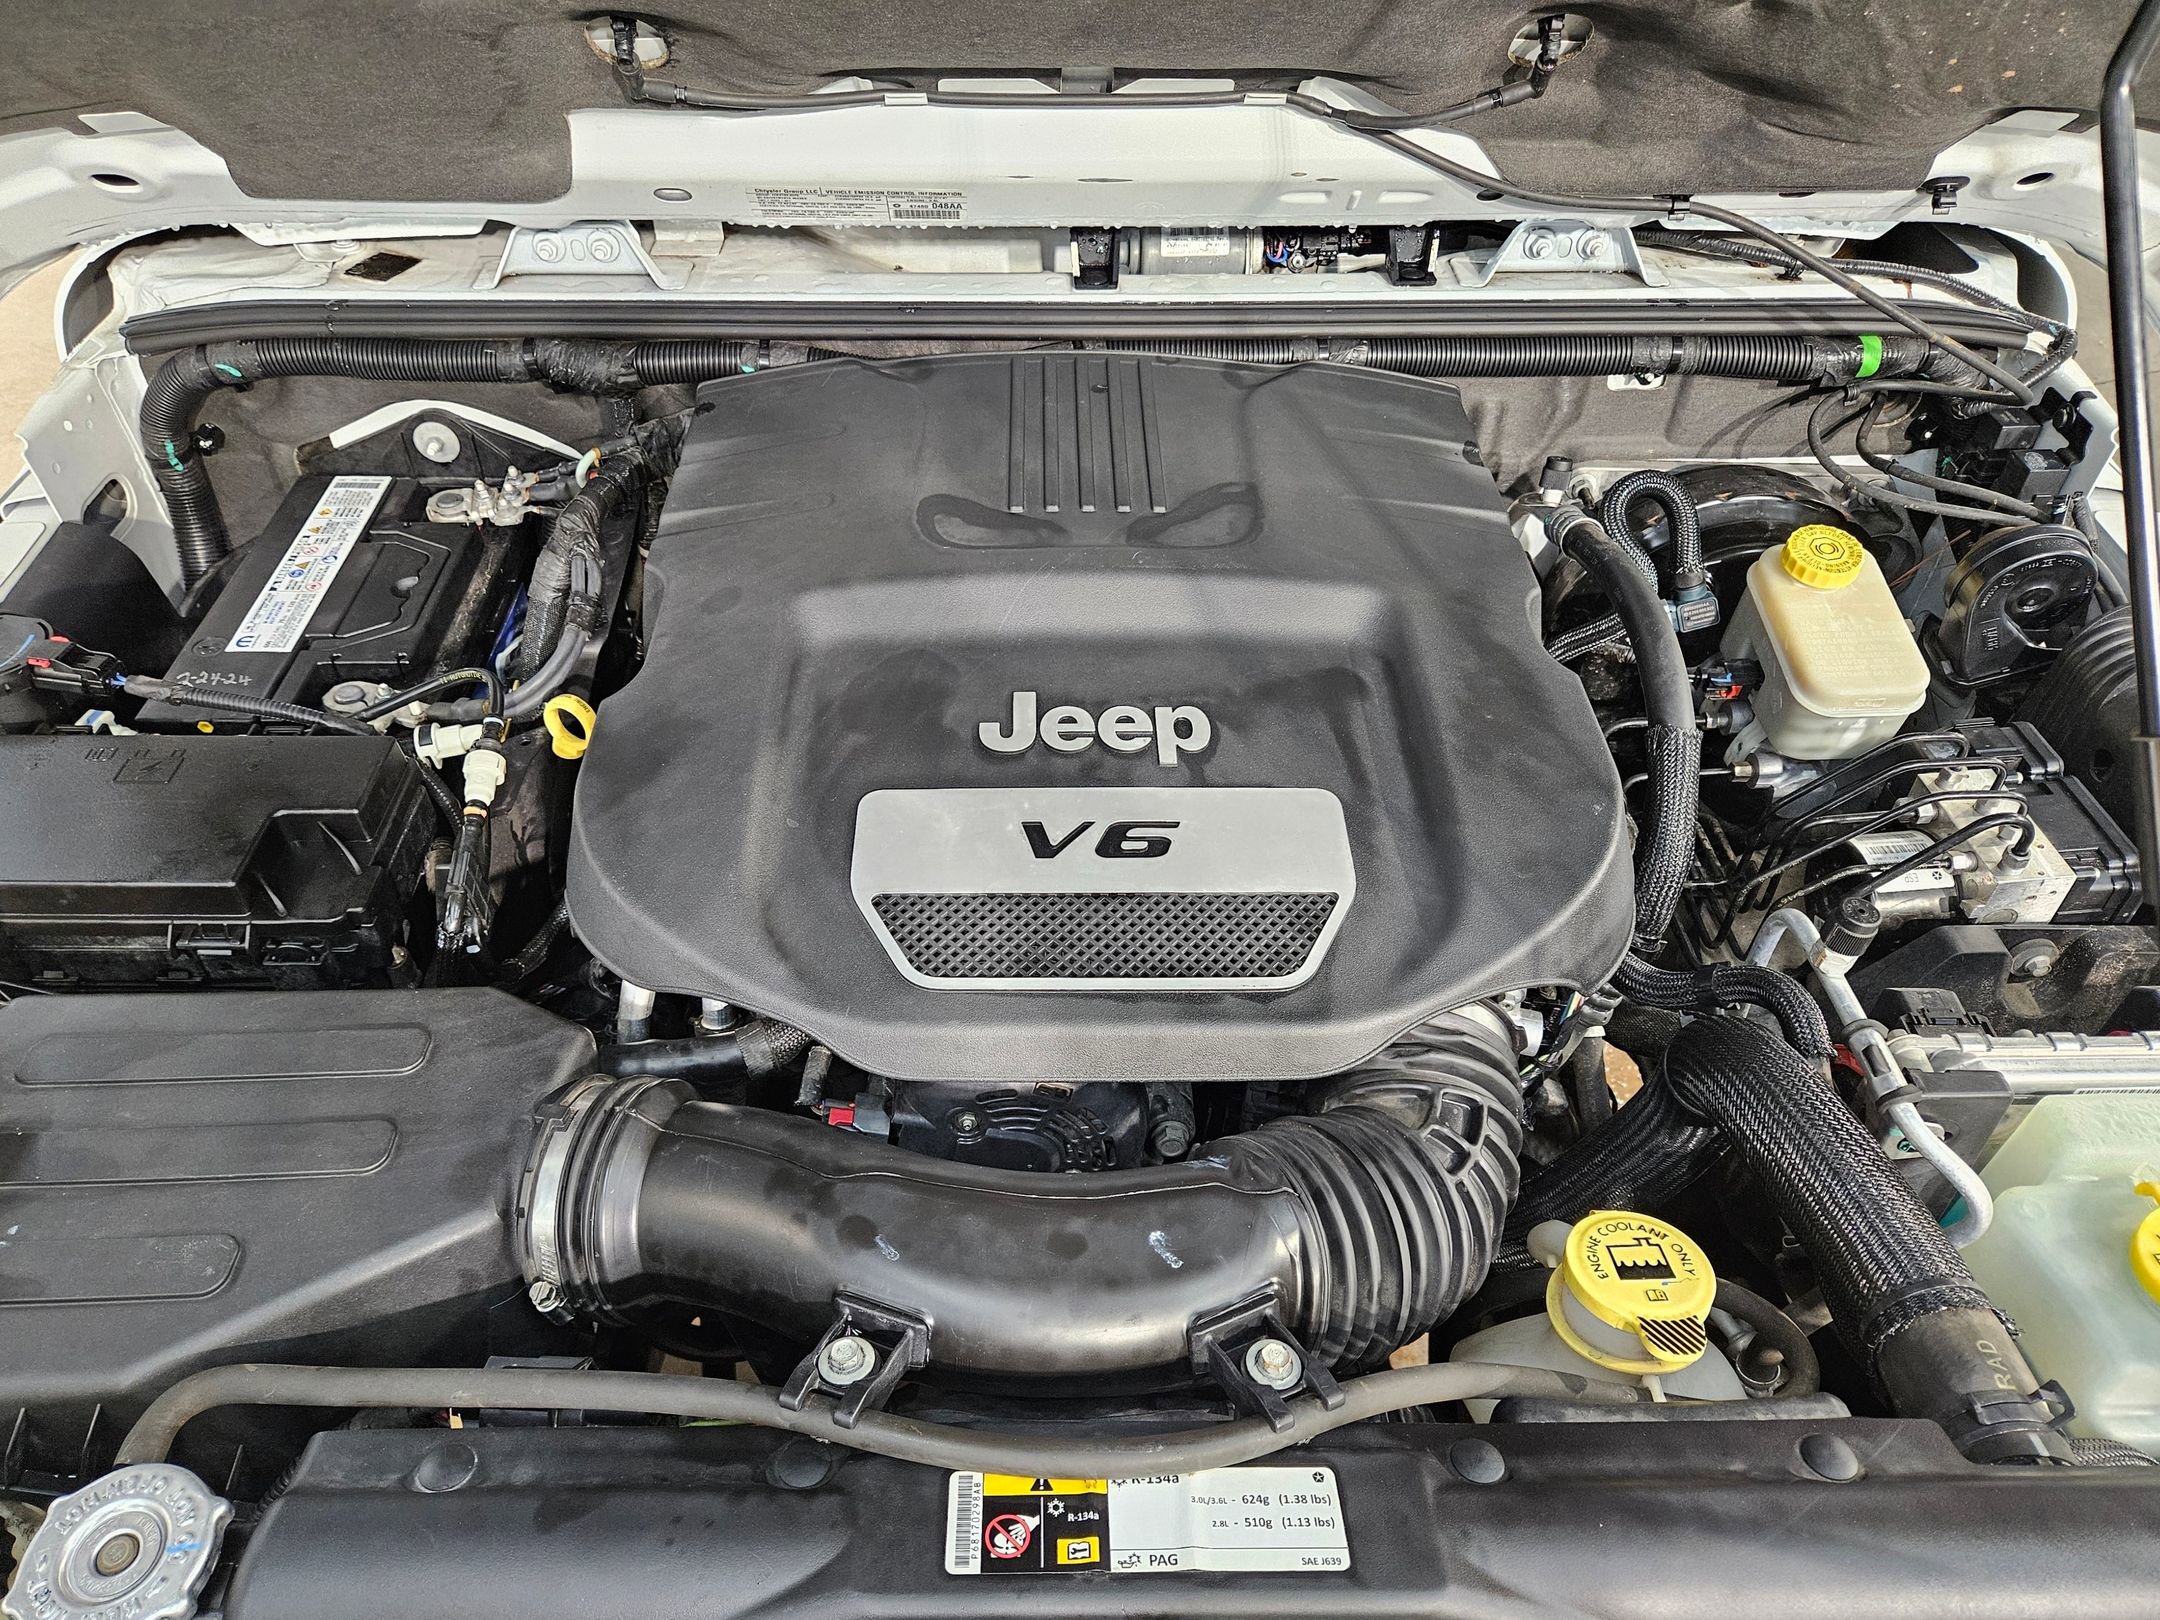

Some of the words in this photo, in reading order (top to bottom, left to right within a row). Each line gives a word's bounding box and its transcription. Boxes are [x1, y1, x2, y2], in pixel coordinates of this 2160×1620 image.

[931, 202, 963, 210] 048AA
[978, 691, 1212, 767] Jeep
[1021, 821, 1181, 859] V6
[1597, 1221, 1670, 1241] COOLANT
[1586, 1235, 1609, 1280] ENGINE
[1671, 1243, 1697, 1277] ONLY
[1976, 1340, 2017, 1389] RAD
[1190, 1495, 1228, 1506] 3.0L/3.6L
[1241, 1494, 1270, 1506] 624g
[1278, 1494, 1308, 1506] (1.38
[1310, 1494, 1332, 1506] lbs)
[971, 1482, 981, 1560] P68170298AB
[1067, 1511, 1100, 1522] R-134a
[1212, 1520, 1229, 1528] 2.8L
[1244, 1517, 1273, 1529] 510g
[1282, 1517, 1311, 1529] (1.13
[1314, 1517, 1335, 1529] lbs)
[1149, 1554, 1178, 1566] PAG
[1301, 1557, 1319, 1566] SAE
[1321, 1557, 1342, 1566] J639
